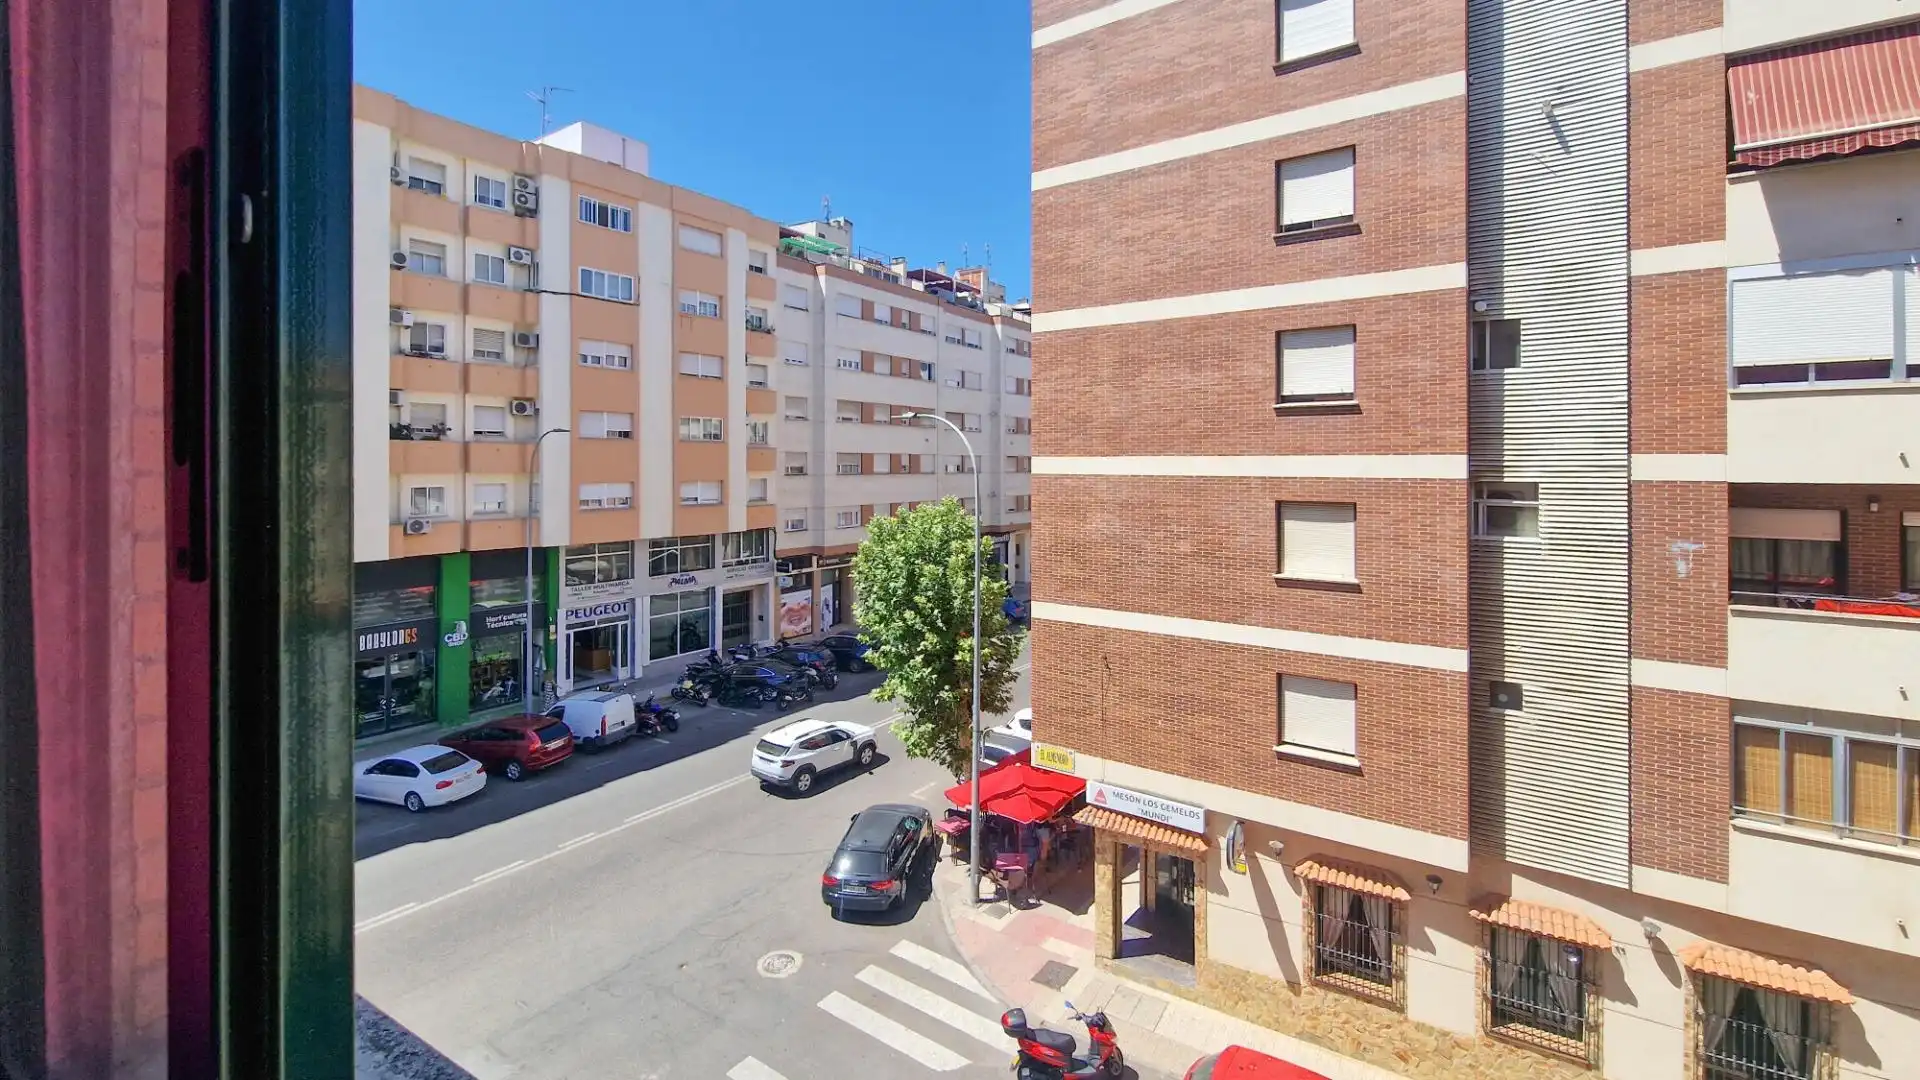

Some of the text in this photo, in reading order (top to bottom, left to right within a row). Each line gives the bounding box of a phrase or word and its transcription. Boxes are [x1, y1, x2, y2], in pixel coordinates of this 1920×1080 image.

[571, 585, 592, 593] TALLER
[565, 601, 630, 621] PEUGEOT
[444, 631, 469, 644] CBD
[1112, 790, 1201, 820] MESON LOS GEMELOS
